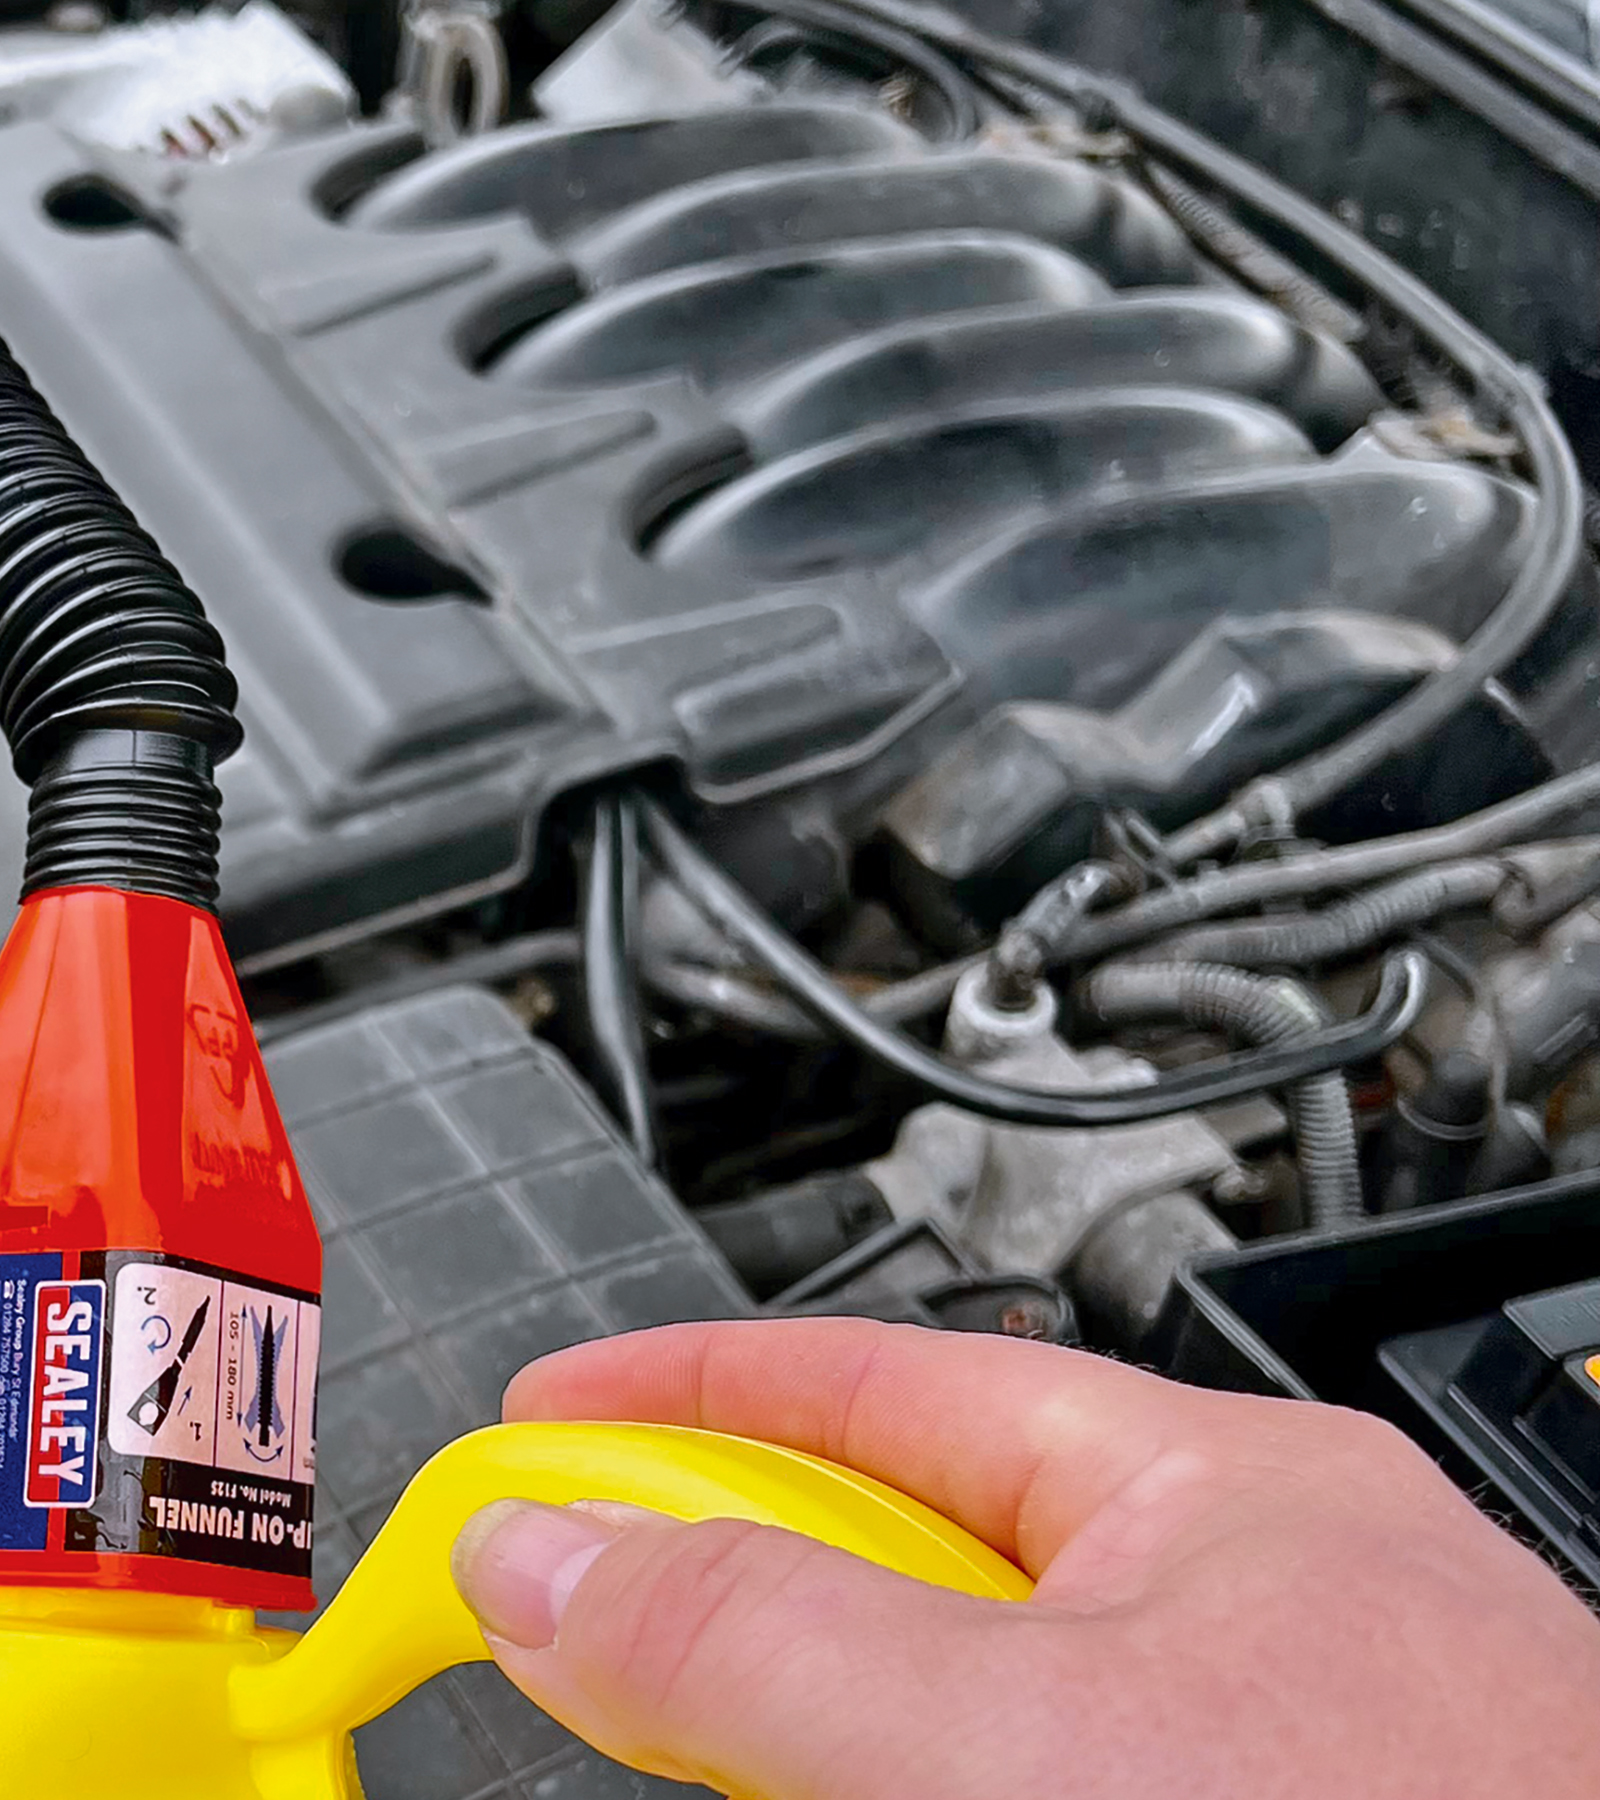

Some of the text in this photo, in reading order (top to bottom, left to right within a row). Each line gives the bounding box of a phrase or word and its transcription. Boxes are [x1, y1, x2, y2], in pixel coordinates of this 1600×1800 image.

[14, 1279, 27, 1314] Sealey
[137, 1286, 157, 1305] 2.
[0, 1303, 13, 1373] 01284 757500
[13, 1316, 25, 1350] Group
[229, 1312, 239, 1339] 105
[11, 1352, 23, 1375] Bury
[228, 1358, 237, 1386] 180
[12, 1377, 21, 1389] St
[37, 1302, 92, 1486] SEALEY
[226, 1391, 234, 1420] mm
[190, 1421, 202, 1441] 1.
[239, 1485, 257, 1502] No.
[260, 1489, 291, 1508] Model
[149, 1496, 245, 1540] FUNNEL
